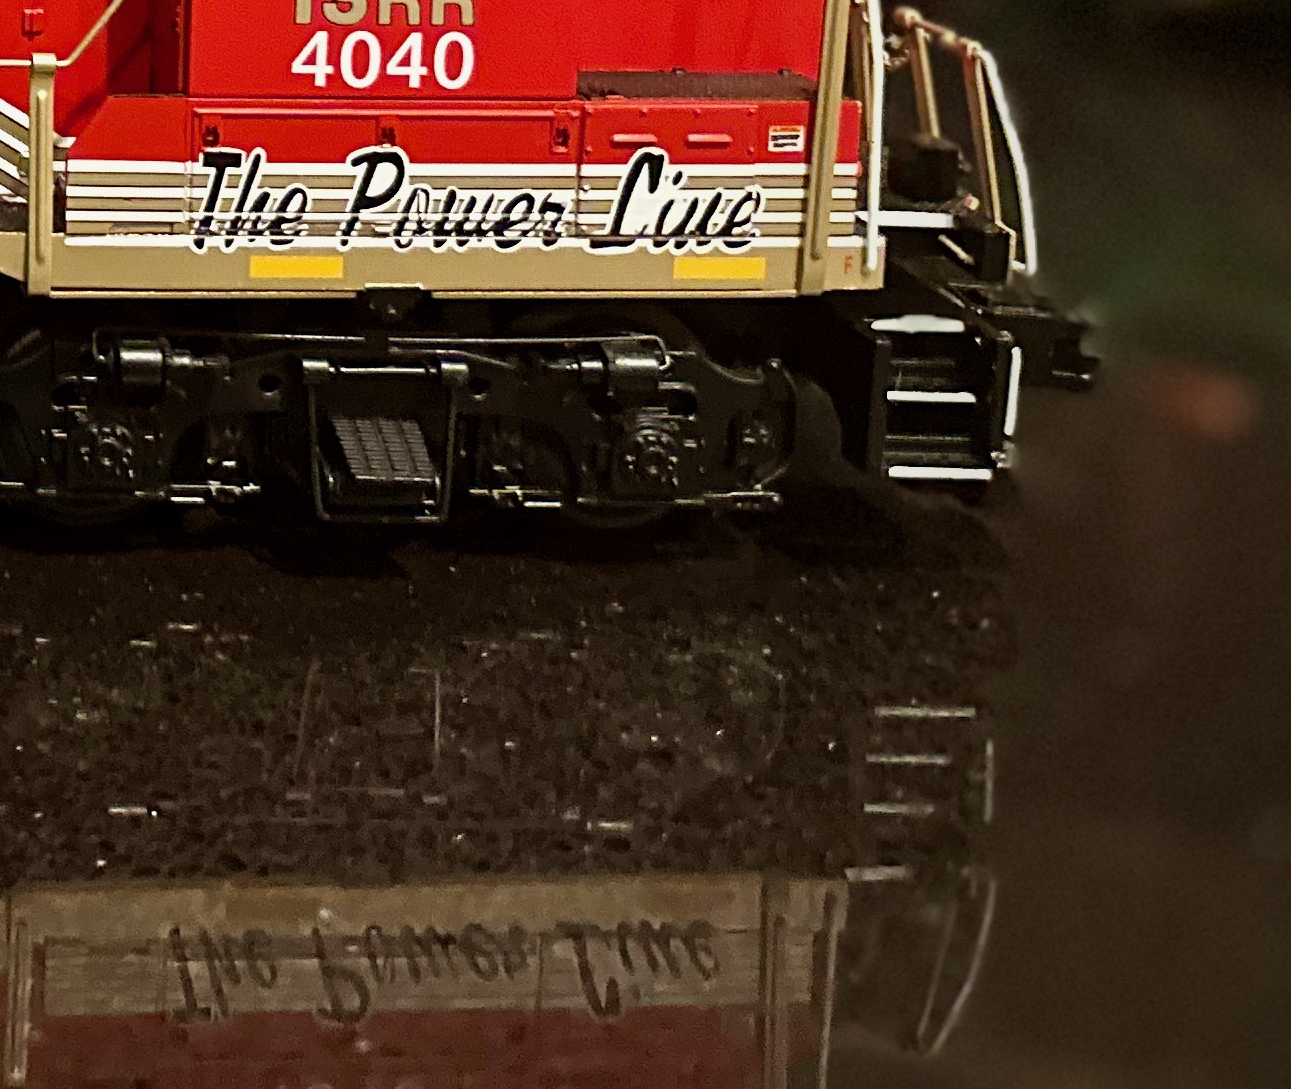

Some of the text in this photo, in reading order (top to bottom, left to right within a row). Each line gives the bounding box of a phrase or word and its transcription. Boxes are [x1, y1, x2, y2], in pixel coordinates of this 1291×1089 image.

[291, 30, 475, 88] 4040
[193, 150, 761, 249] The Power Line
